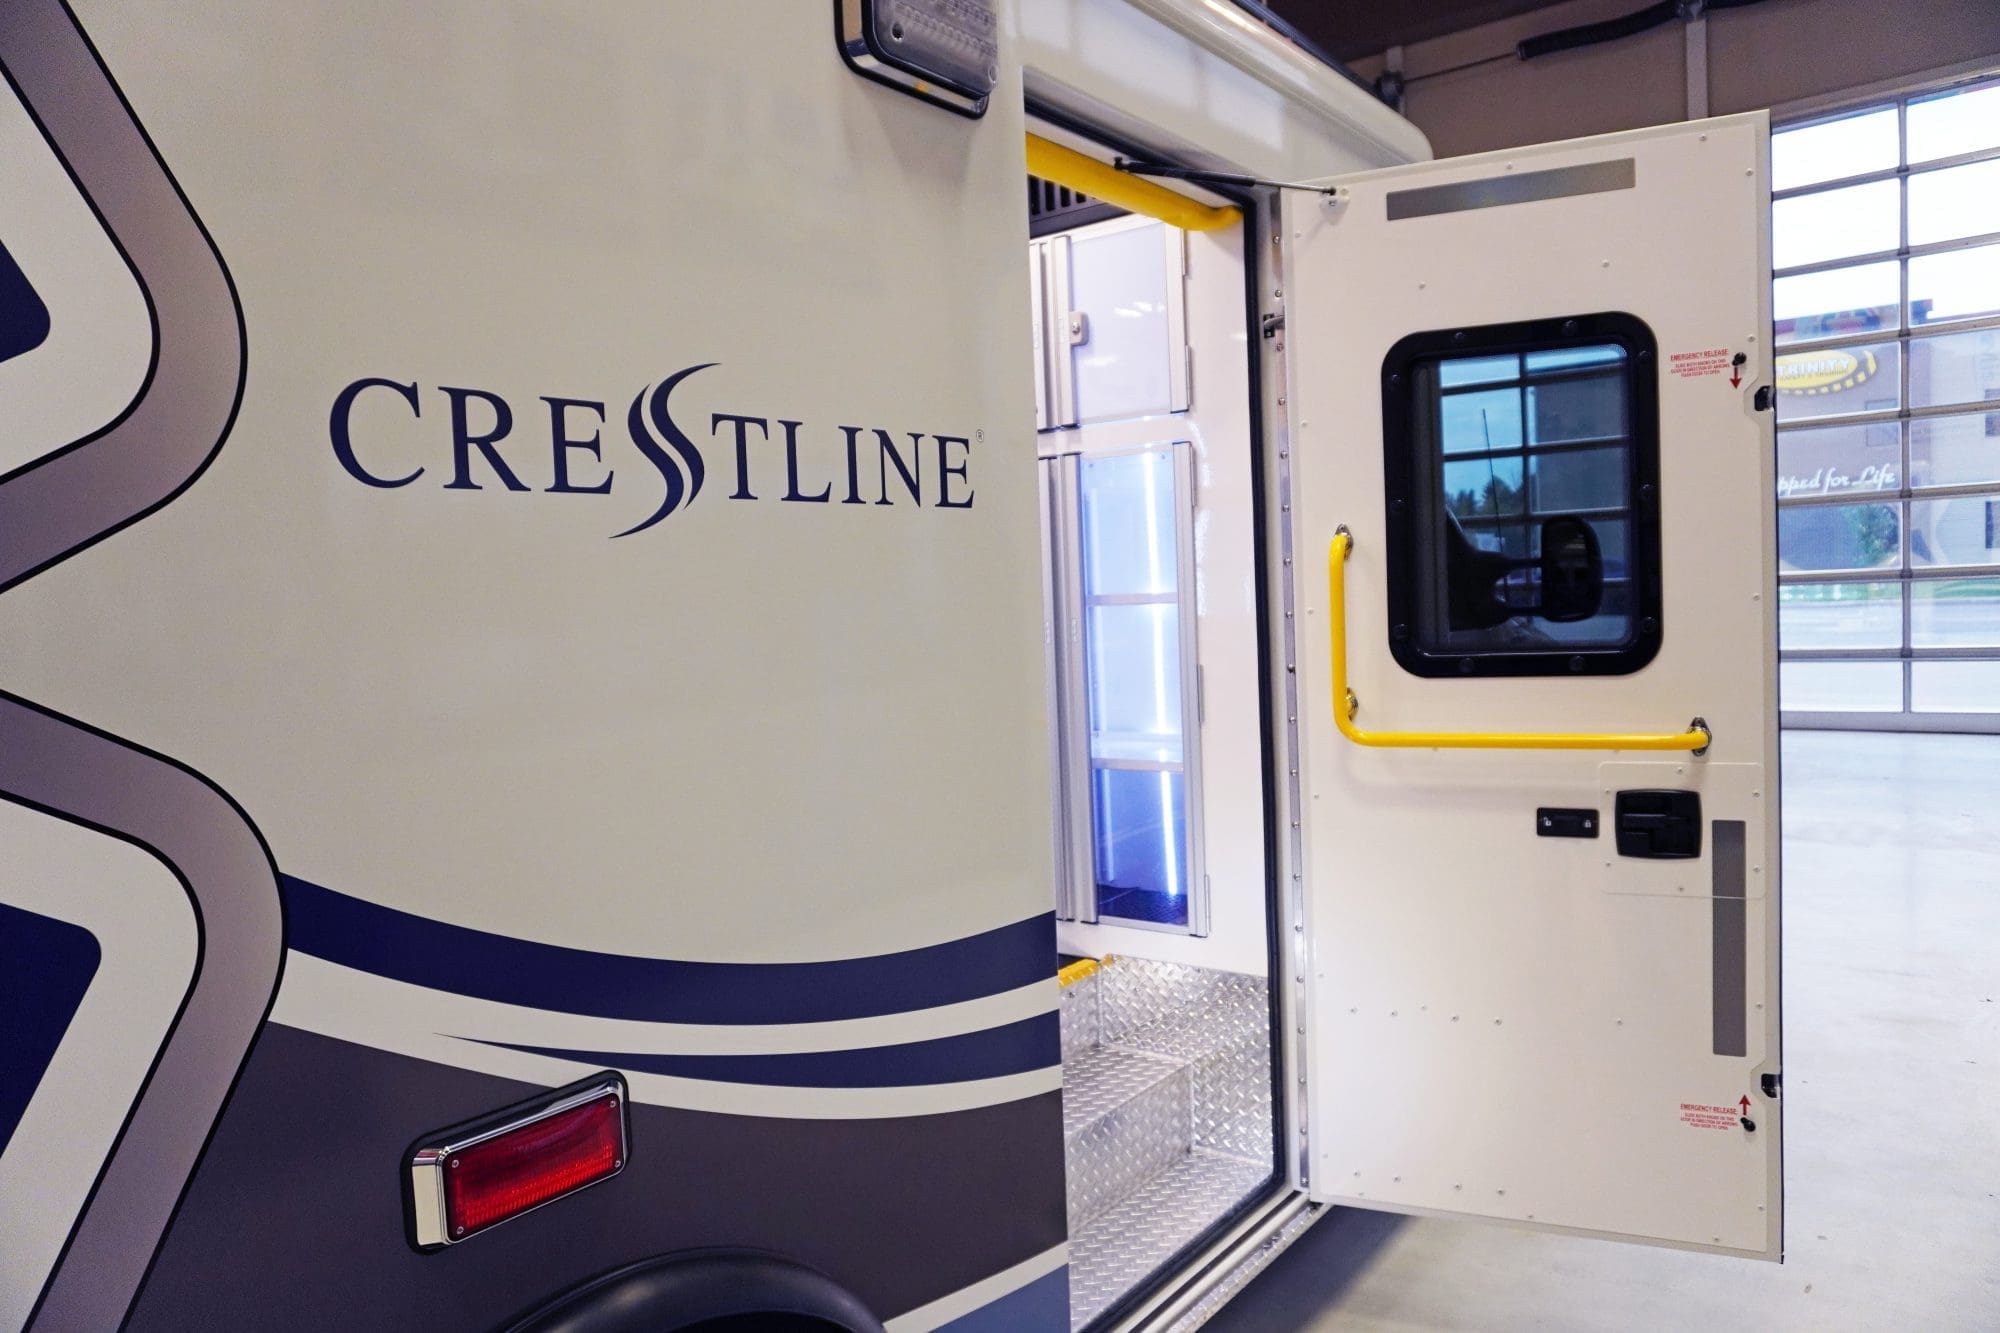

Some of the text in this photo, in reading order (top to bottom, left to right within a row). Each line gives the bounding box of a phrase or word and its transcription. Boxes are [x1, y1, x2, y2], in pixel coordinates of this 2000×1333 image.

[1670, 352, 1702, 361] EMERGENCY
[1776, 359, 1850, 377] TRINITY
[329, 363, 976, 538] CRESTLINE
[1822, 466, 1850, 495] for
[1851, 463, 1896, 492] Life
[1680, 1103, 1712, 1112] EMERGENCY
